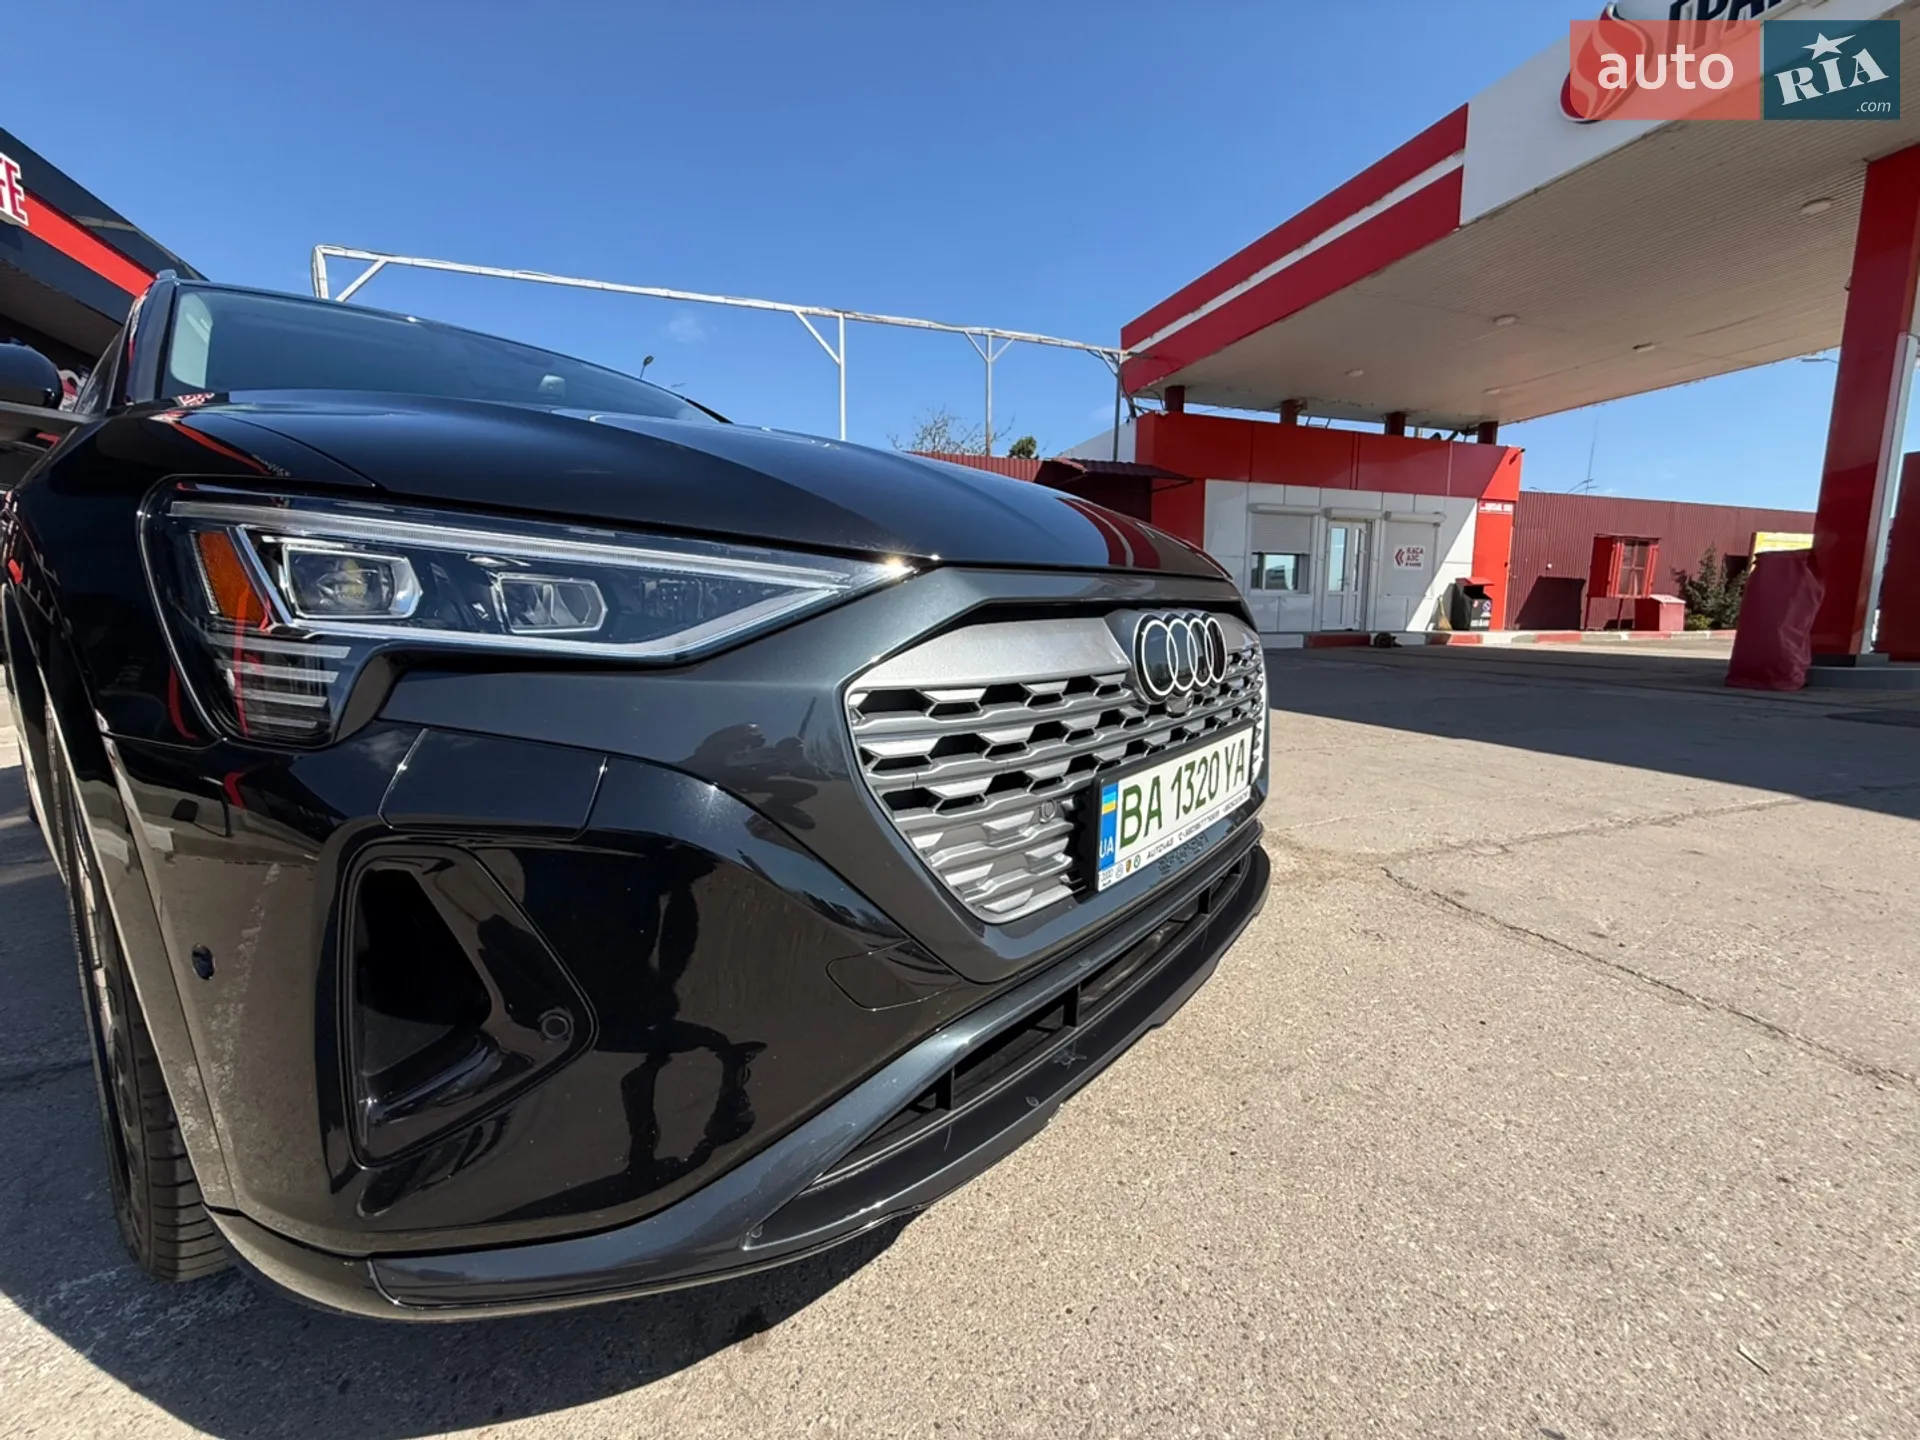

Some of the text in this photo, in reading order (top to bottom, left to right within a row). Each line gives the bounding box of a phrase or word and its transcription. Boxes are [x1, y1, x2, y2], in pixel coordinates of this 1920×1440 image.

[1666, 0, 1781, 63] ГРА
[1120, 775, 1162, 849] BA
[1171, 751, 1220, 821] 1320
[1225, 738, 1245, 793] YA
[1099, 836, 1114, 858] UA
